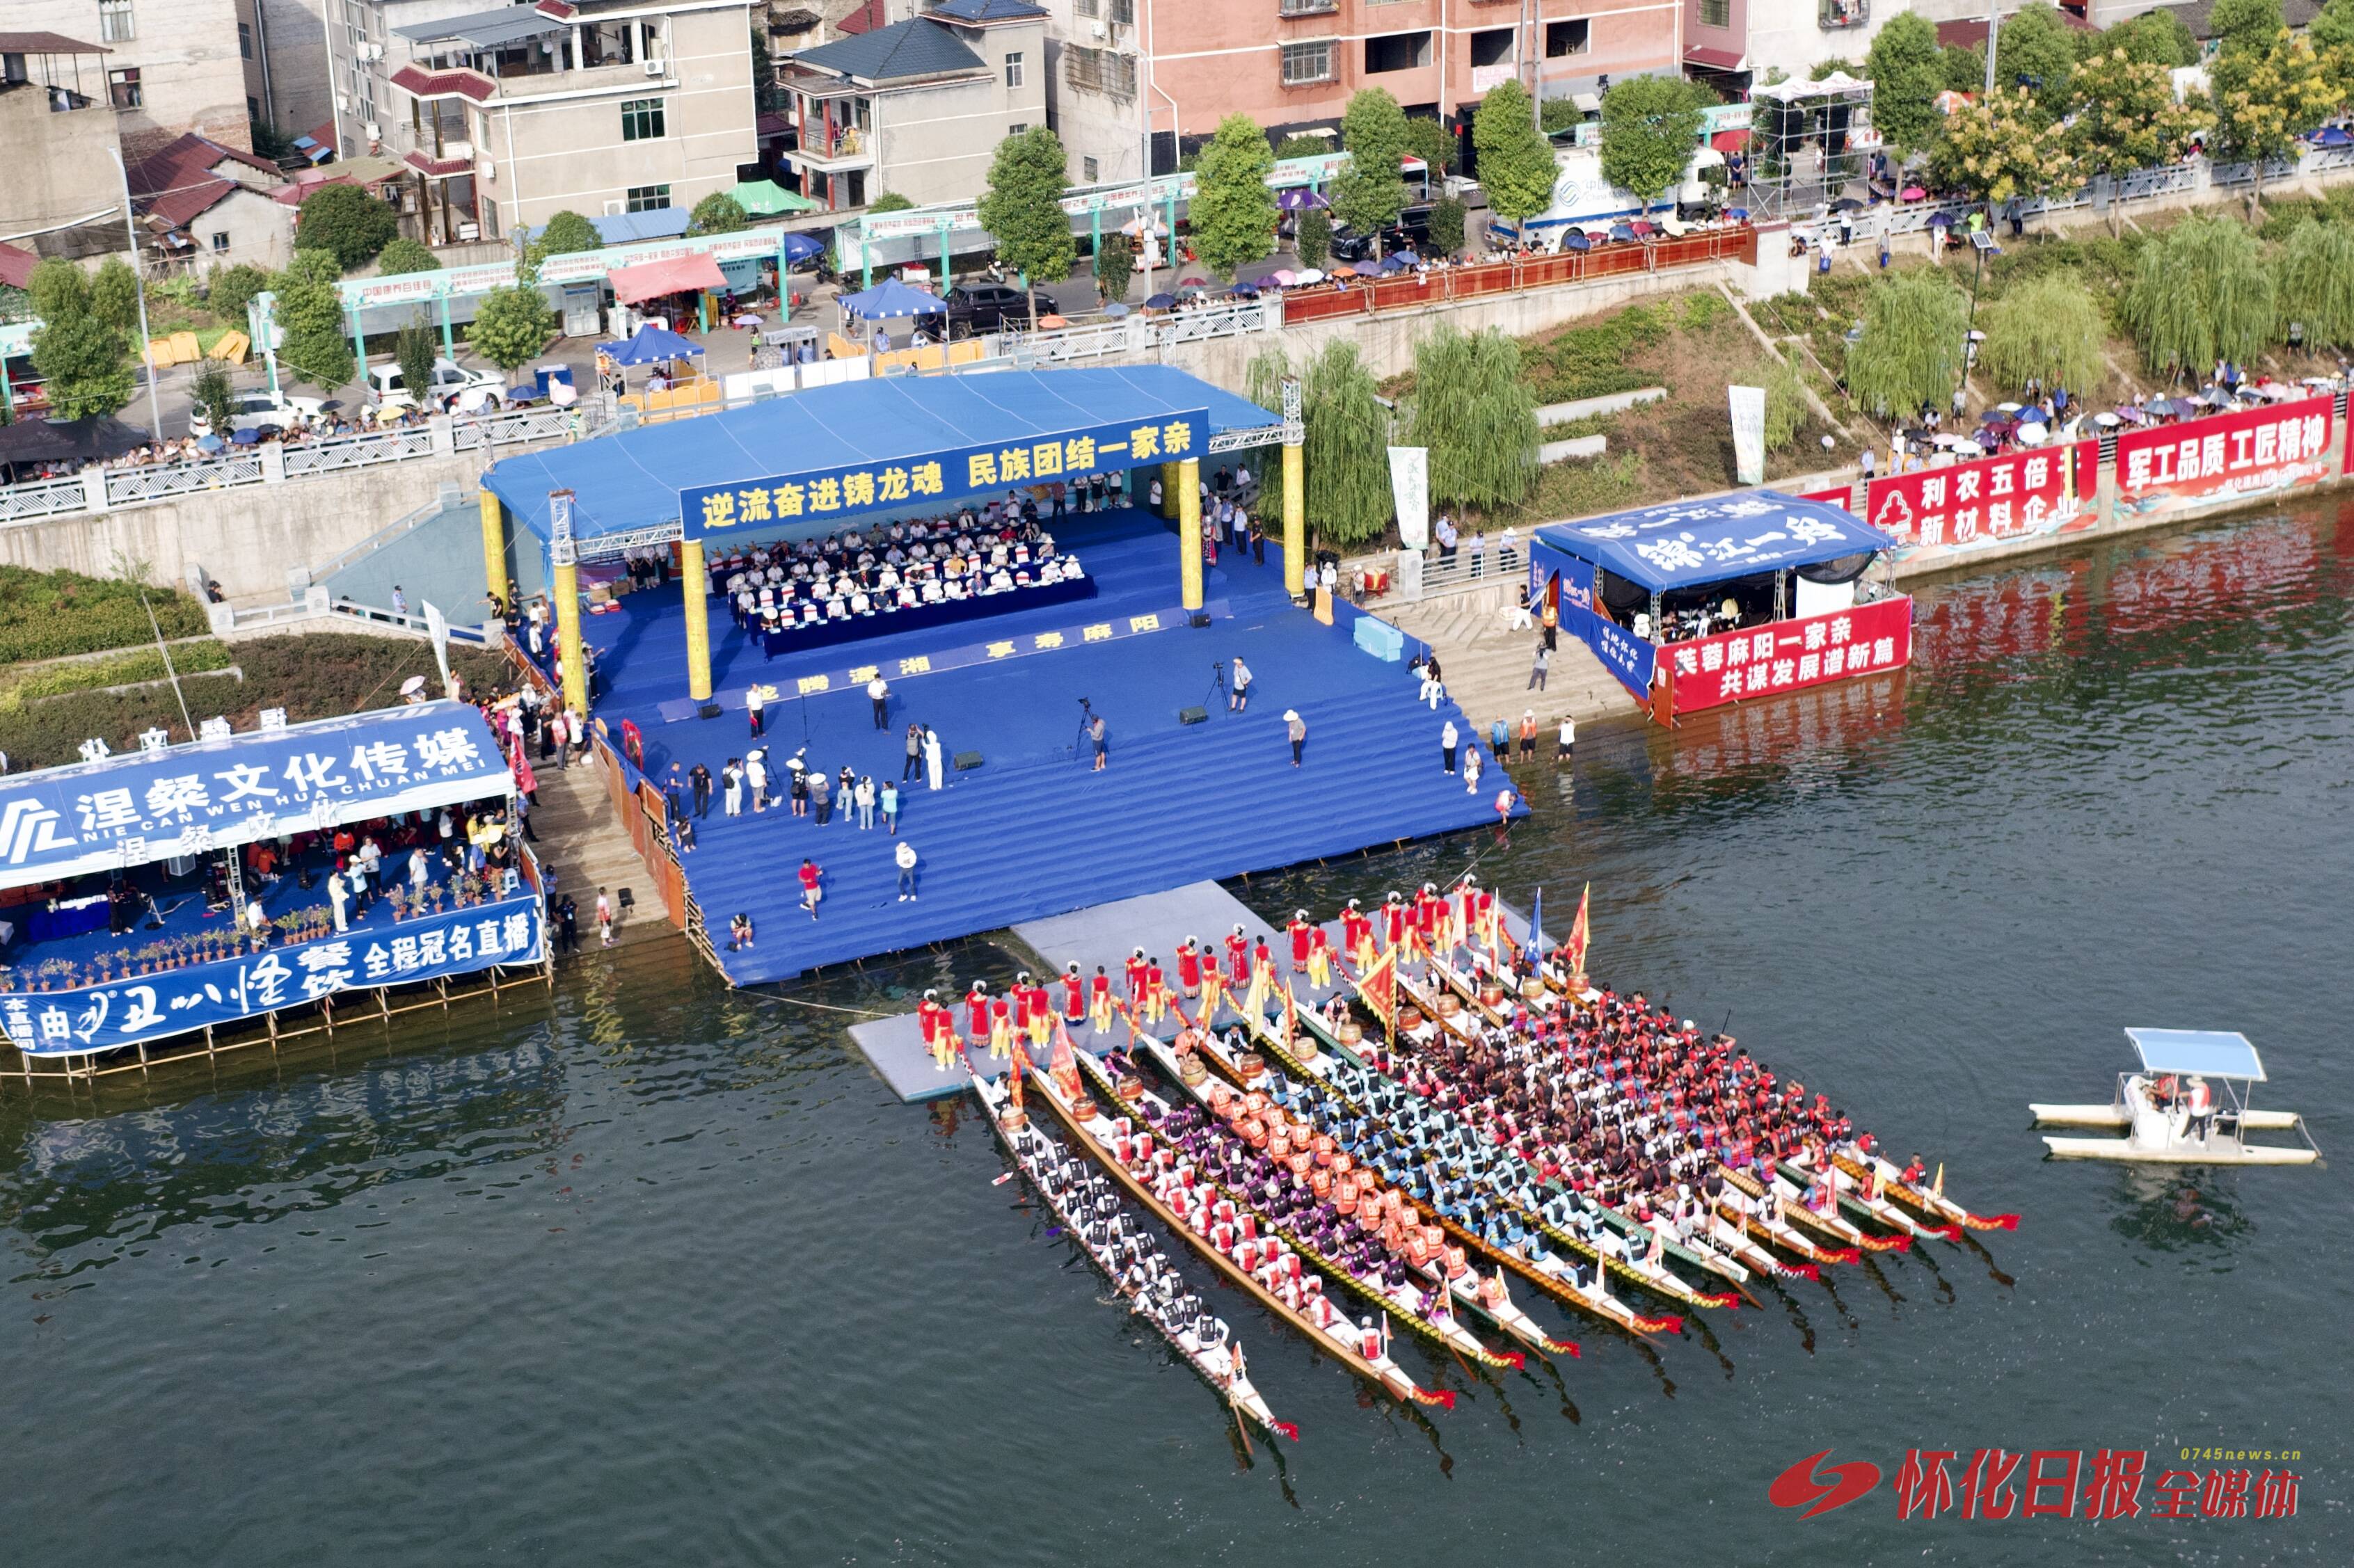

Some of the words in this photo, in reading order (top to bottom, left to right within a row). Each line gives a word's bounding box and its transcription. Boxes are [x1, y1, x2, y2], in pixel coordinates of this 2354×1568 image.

[701, 461, 944, 529] 逆流奋进铸龙魂
[968, 420, 1191, 488] 民族团结一家亲
[2126, 431, 2226, 491] 军工品质
[2229, 413, 2325, 471] 工匠精神
[1919, 495, 2080, 547] 新材料企业
[986, 614, 1159, 659] 享寿麻阳
[1673, 616, 1852, 678] 芙蓉麻阳一家亲
[1719, 636, 1895, 698] 共谋发展谱新篇
[83, 826, 127, 842] NIE
[141, 812, 193, 831] CAN
[207, 797, 262, 815] WEN
[275, 788, 326, 806] HUA
[340, 770, 427, 794] CHUAN
[440, 758, 485, 776] MEI
[40, 1005, 70, 1040] 由
[363, 912, 530, 978] 全程冠名直播
